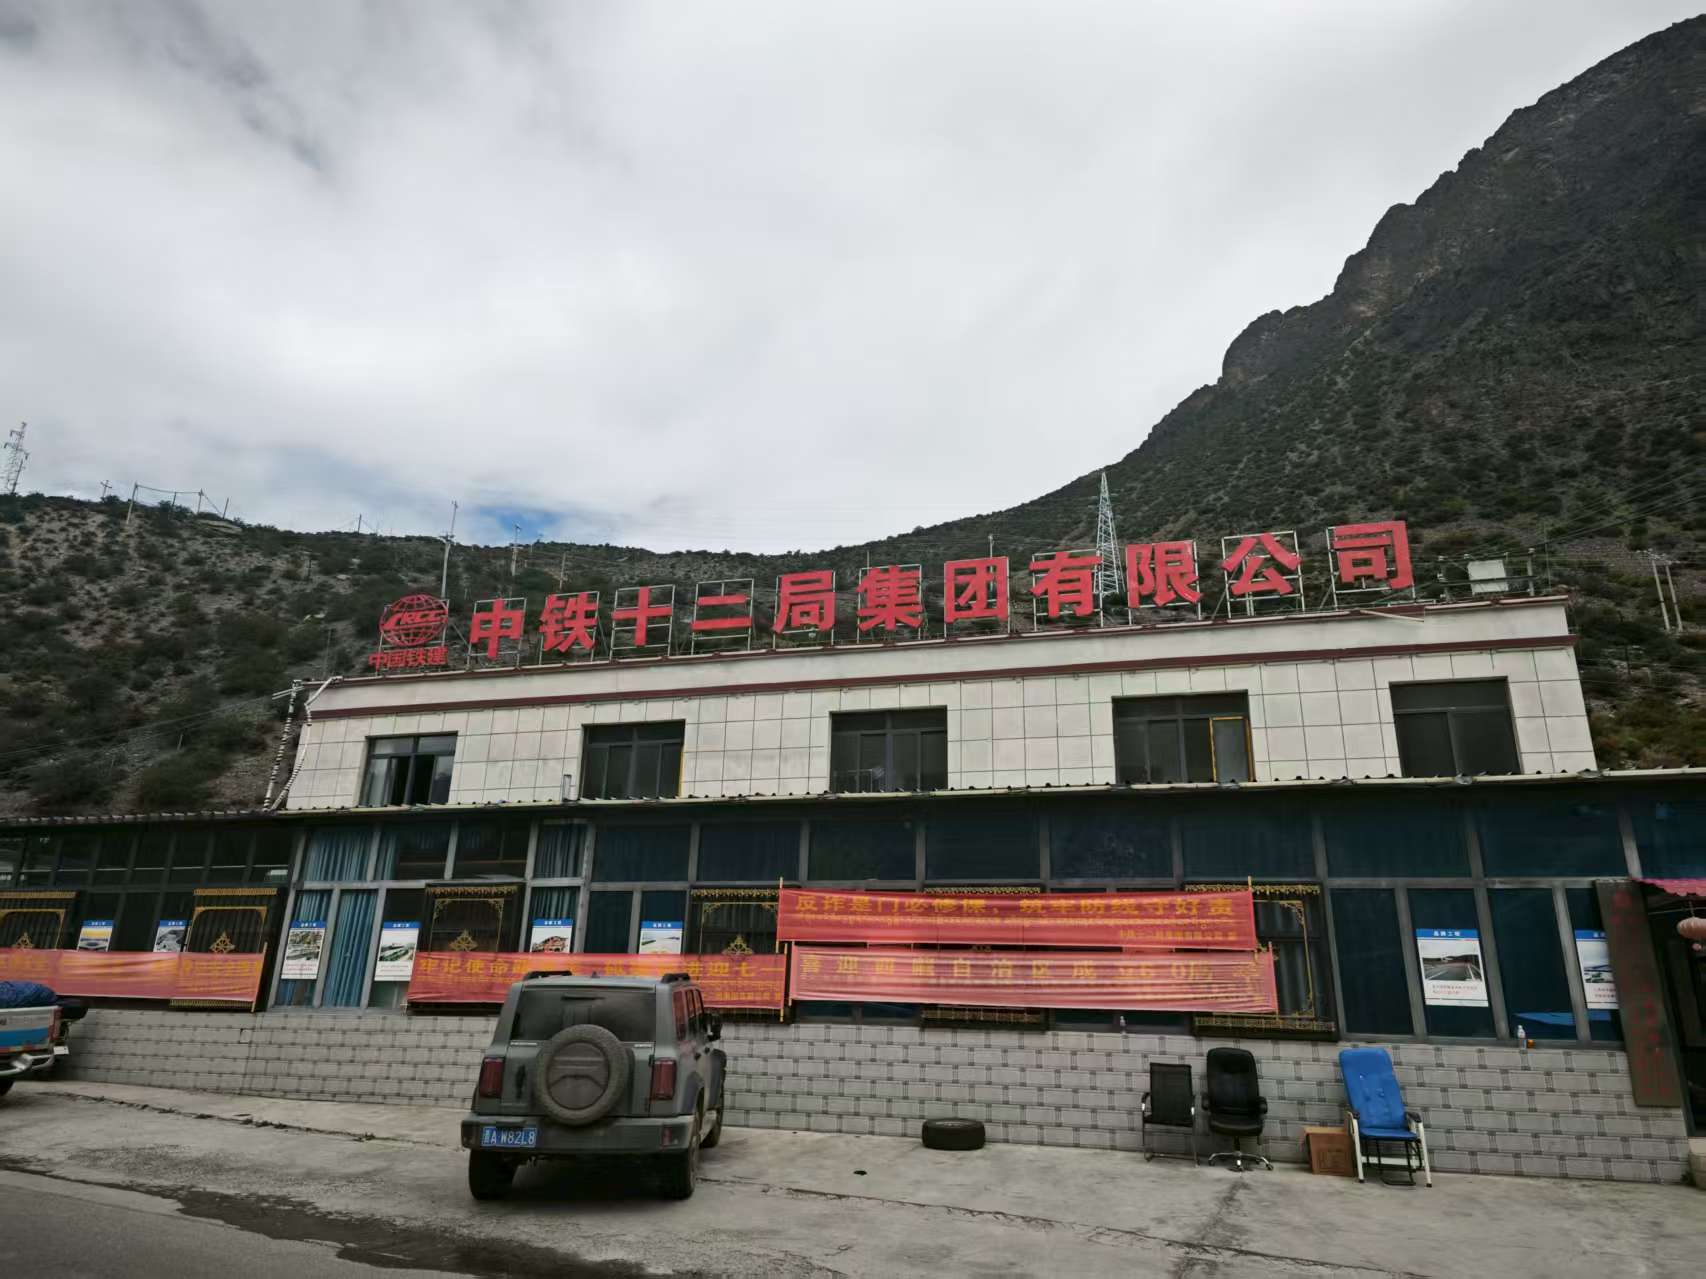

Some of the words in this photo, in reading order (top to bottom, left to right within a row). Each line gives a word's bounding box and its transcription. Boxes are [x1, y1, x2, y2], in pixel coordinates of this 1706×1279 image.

[469, 521, 1414, 659] 中铁十二局集团有限公司
[368, 646, 449, 672] 中国铁建
